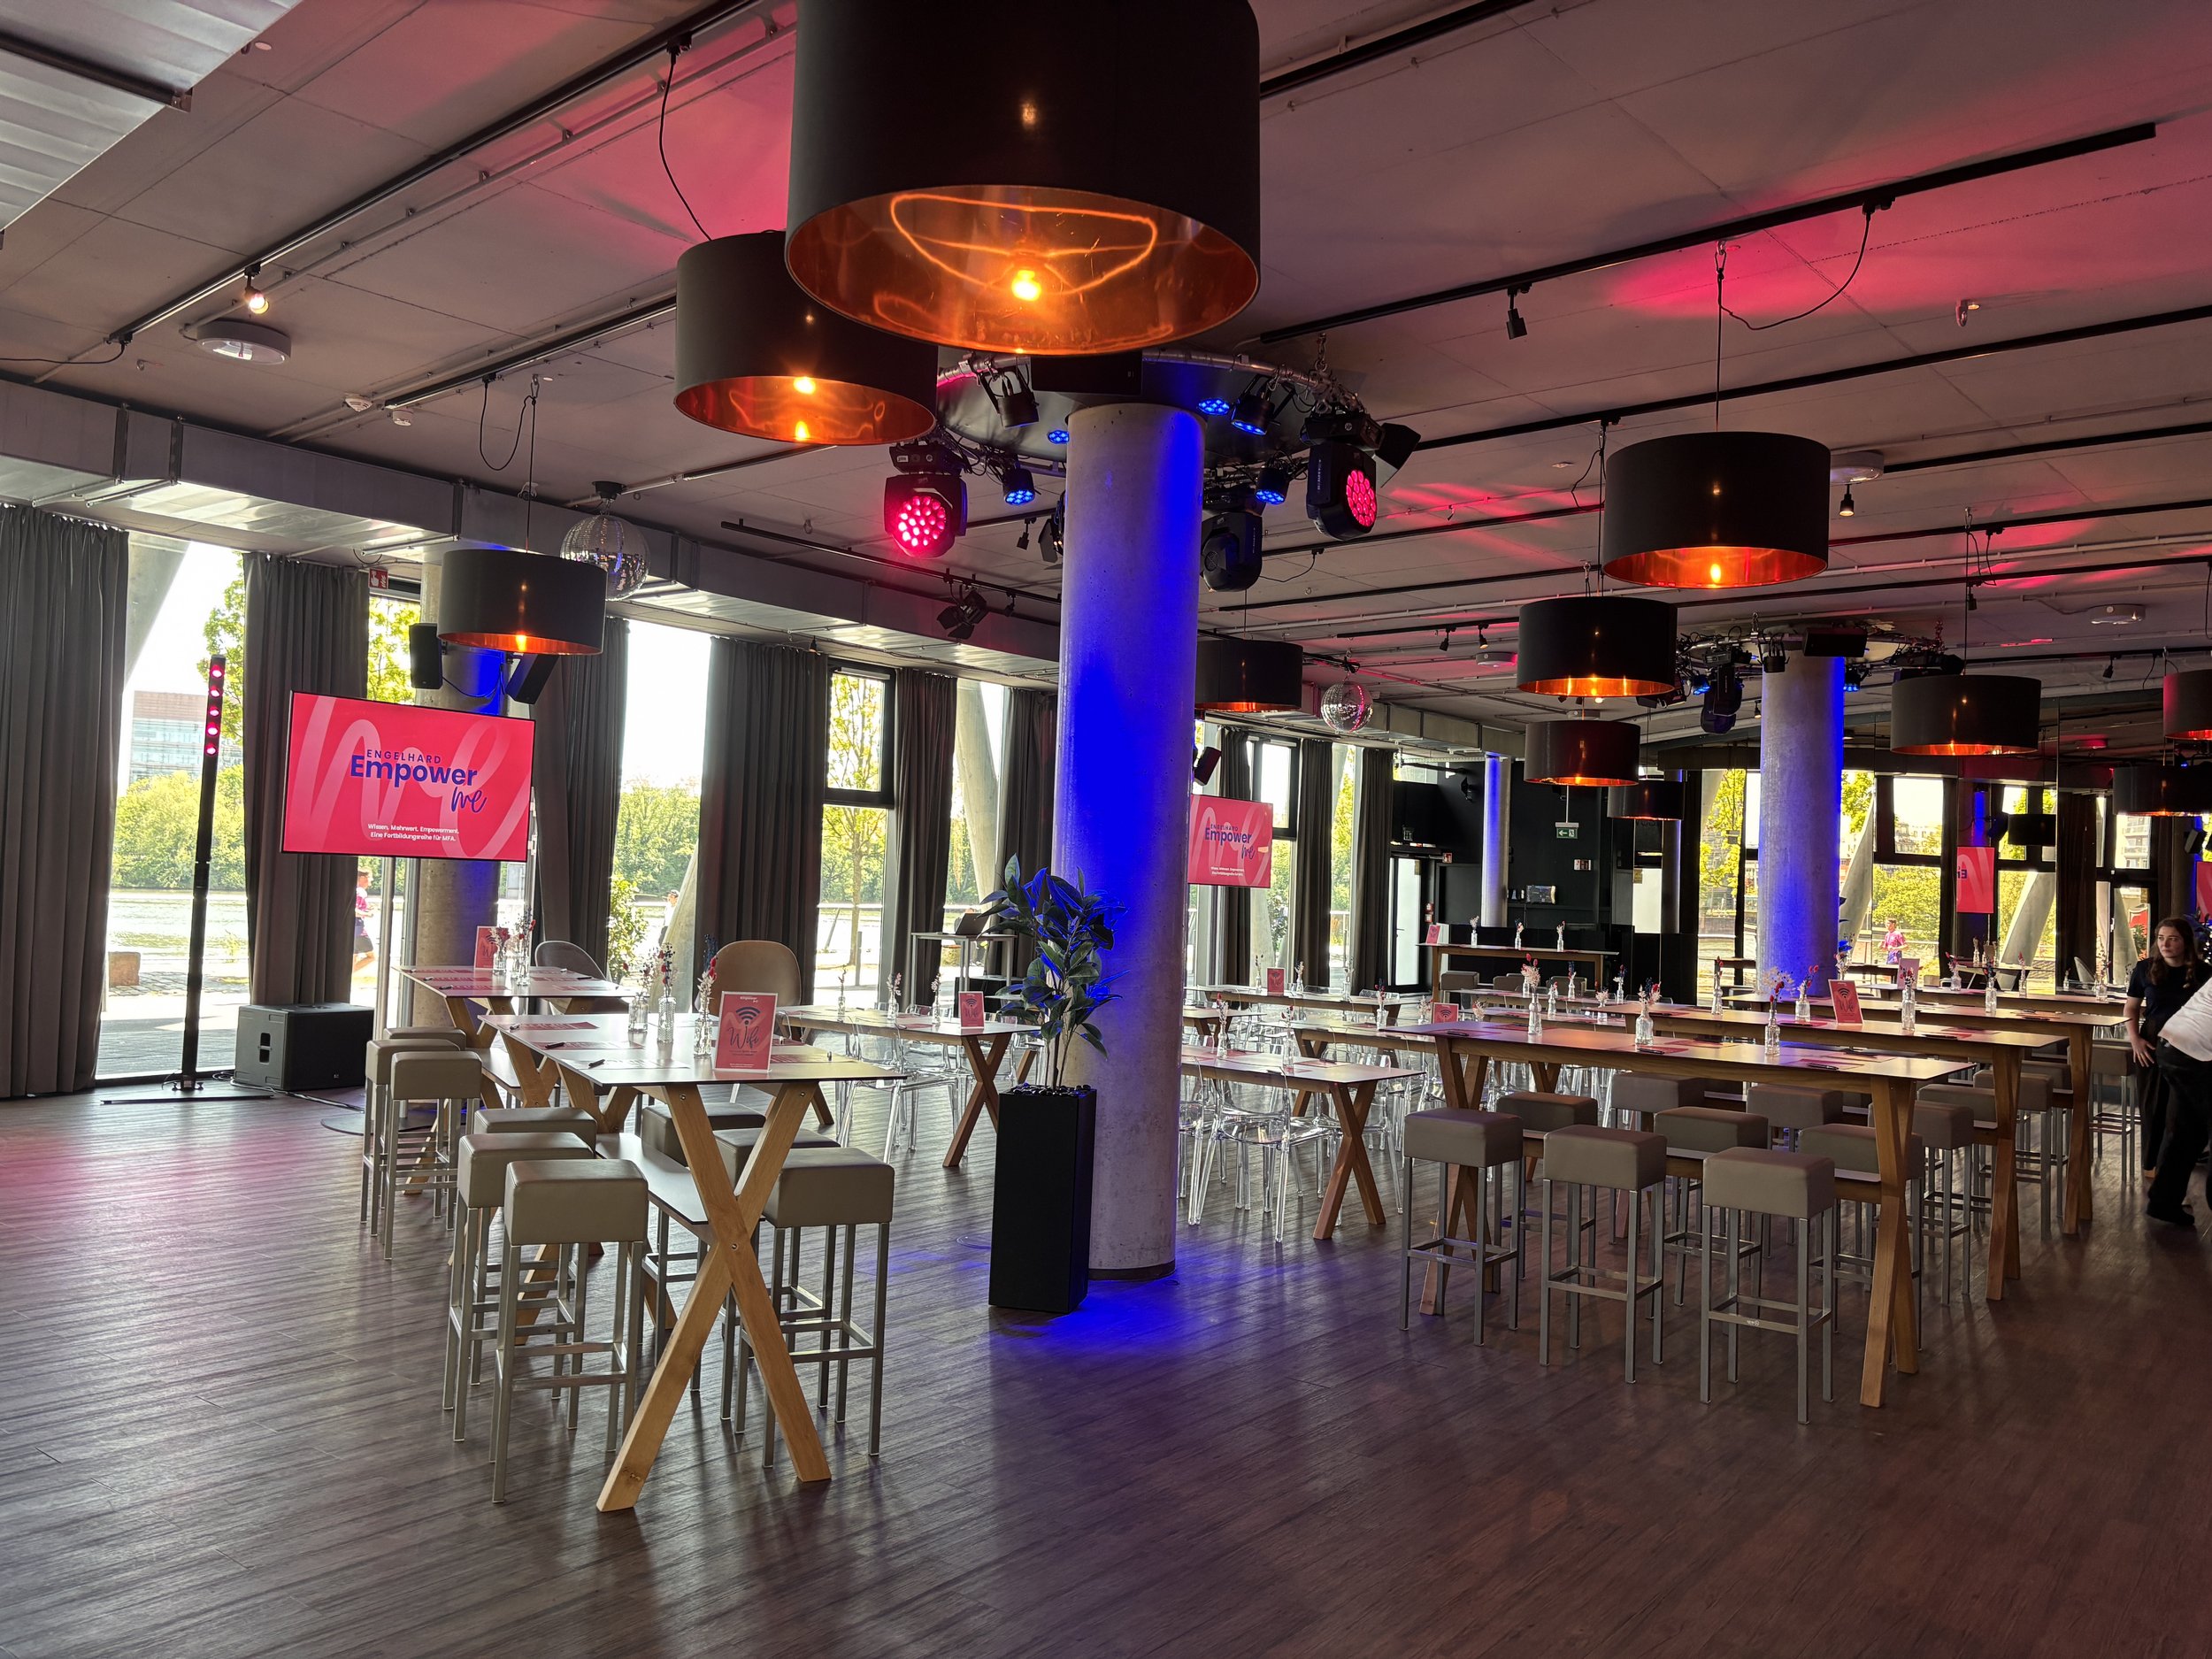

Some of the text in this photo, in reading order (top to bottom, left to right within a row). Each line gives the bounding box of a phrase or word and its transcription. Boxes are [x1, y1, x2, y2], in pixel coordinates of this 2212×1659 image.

[366, 749, 442, 764] ENGELHARD
[350, 755, 478, 787] Empower
[451, 786, 487, 813] me
[383, 832, 433, 841] Fortbildungsreihe
[419, 826, 459, 834] Empowerment.
[1204, 827, 1252, 846] Empower
[727, 1025, 760, 1049] Wifi
